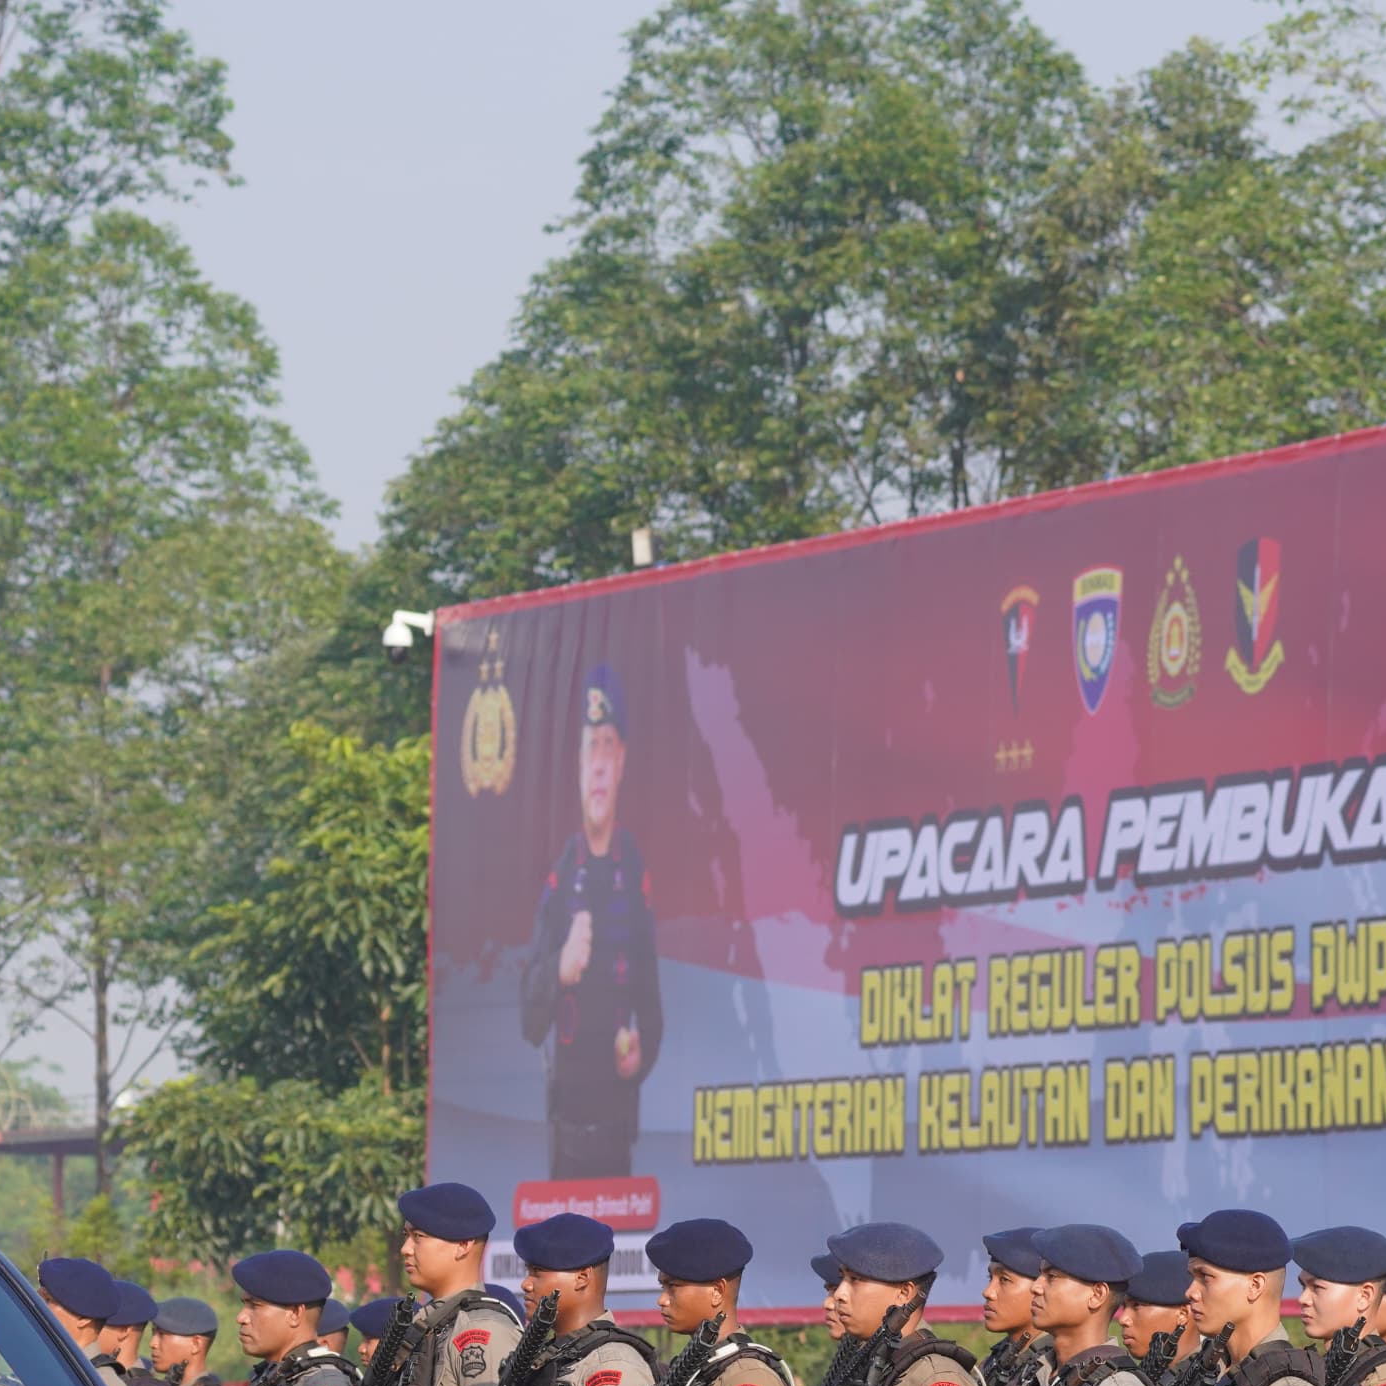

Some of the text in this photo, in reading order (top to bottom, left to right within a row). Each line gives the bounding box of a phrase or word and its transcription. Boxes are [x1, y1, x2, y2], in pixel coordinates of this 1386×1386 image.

[835, 802, 1087, 910] UPACARA
[860, 958, 977, 1048] DIKLAT
[987, 944, 1141, 1038] REGULER
[1156, 930, 1294, 1024] POLSUS
[694, 1076, 905, 1163] KEMENTERIAN
[918, 1062, 1090, 1152] KELAUTAN
[1105, 1057, 1175, 1143] DAN
